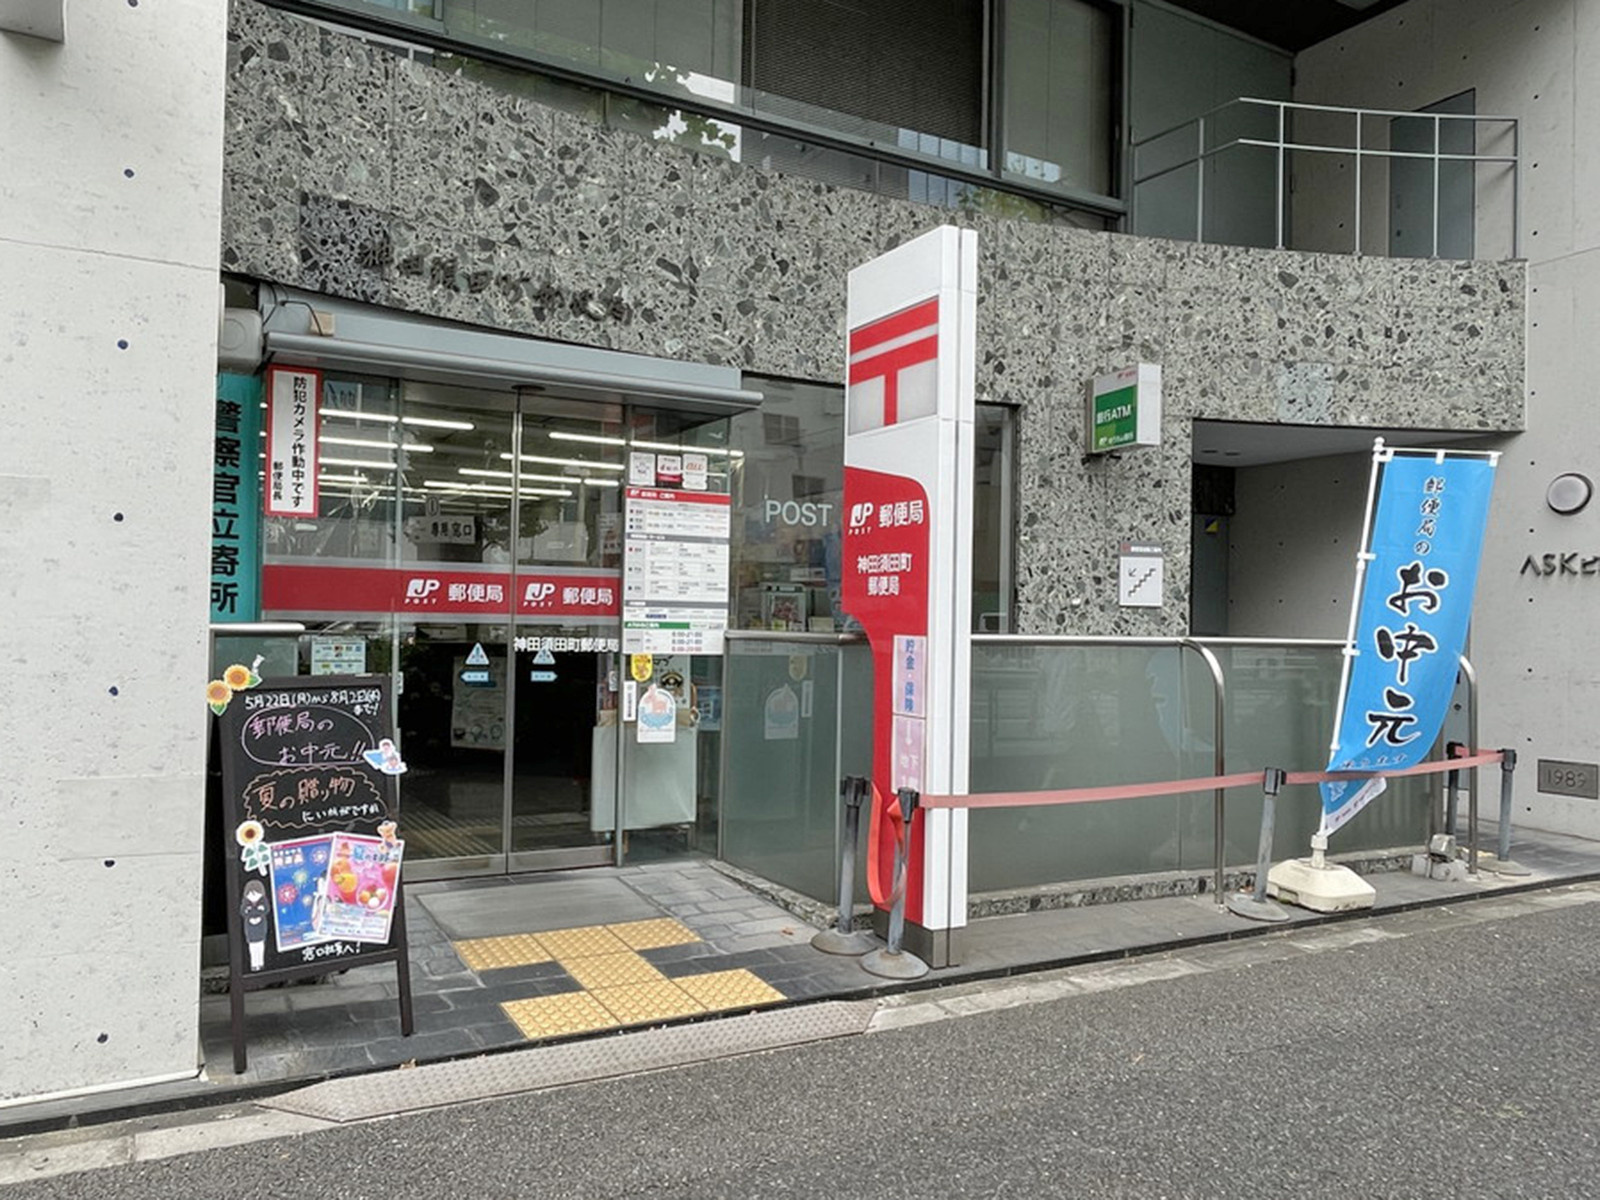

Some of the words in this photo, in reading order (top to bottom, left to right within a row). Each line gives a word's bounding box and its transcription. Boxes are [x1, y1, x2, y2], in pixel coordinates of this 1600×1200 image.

[291, 376, 308, 508] 防犯カメラ作動中です
[272, 461, 284, 501] 郵便局長
[210, 400, 242, 614] 警察官立寄所
[764, 499, 833, 527] POST
[878, 499, 924, 529] 郵便局
[1414, 475, 1446, 556] 郵便局の
[857, 552, 913, 575] 神田須田町
[448, 583, 504, 603] 郵便局
[562, 586, 613, 606] 郵便局
[867, 575, 900, 597] 郵便局
[513, 636, 620, 653] 神田須田町郵便局
[1366, 560, 1449, 748] お中元
[250, 711, 334, 740] 郵便局の
[252, 776, 356, 811] 夏の贈り物
